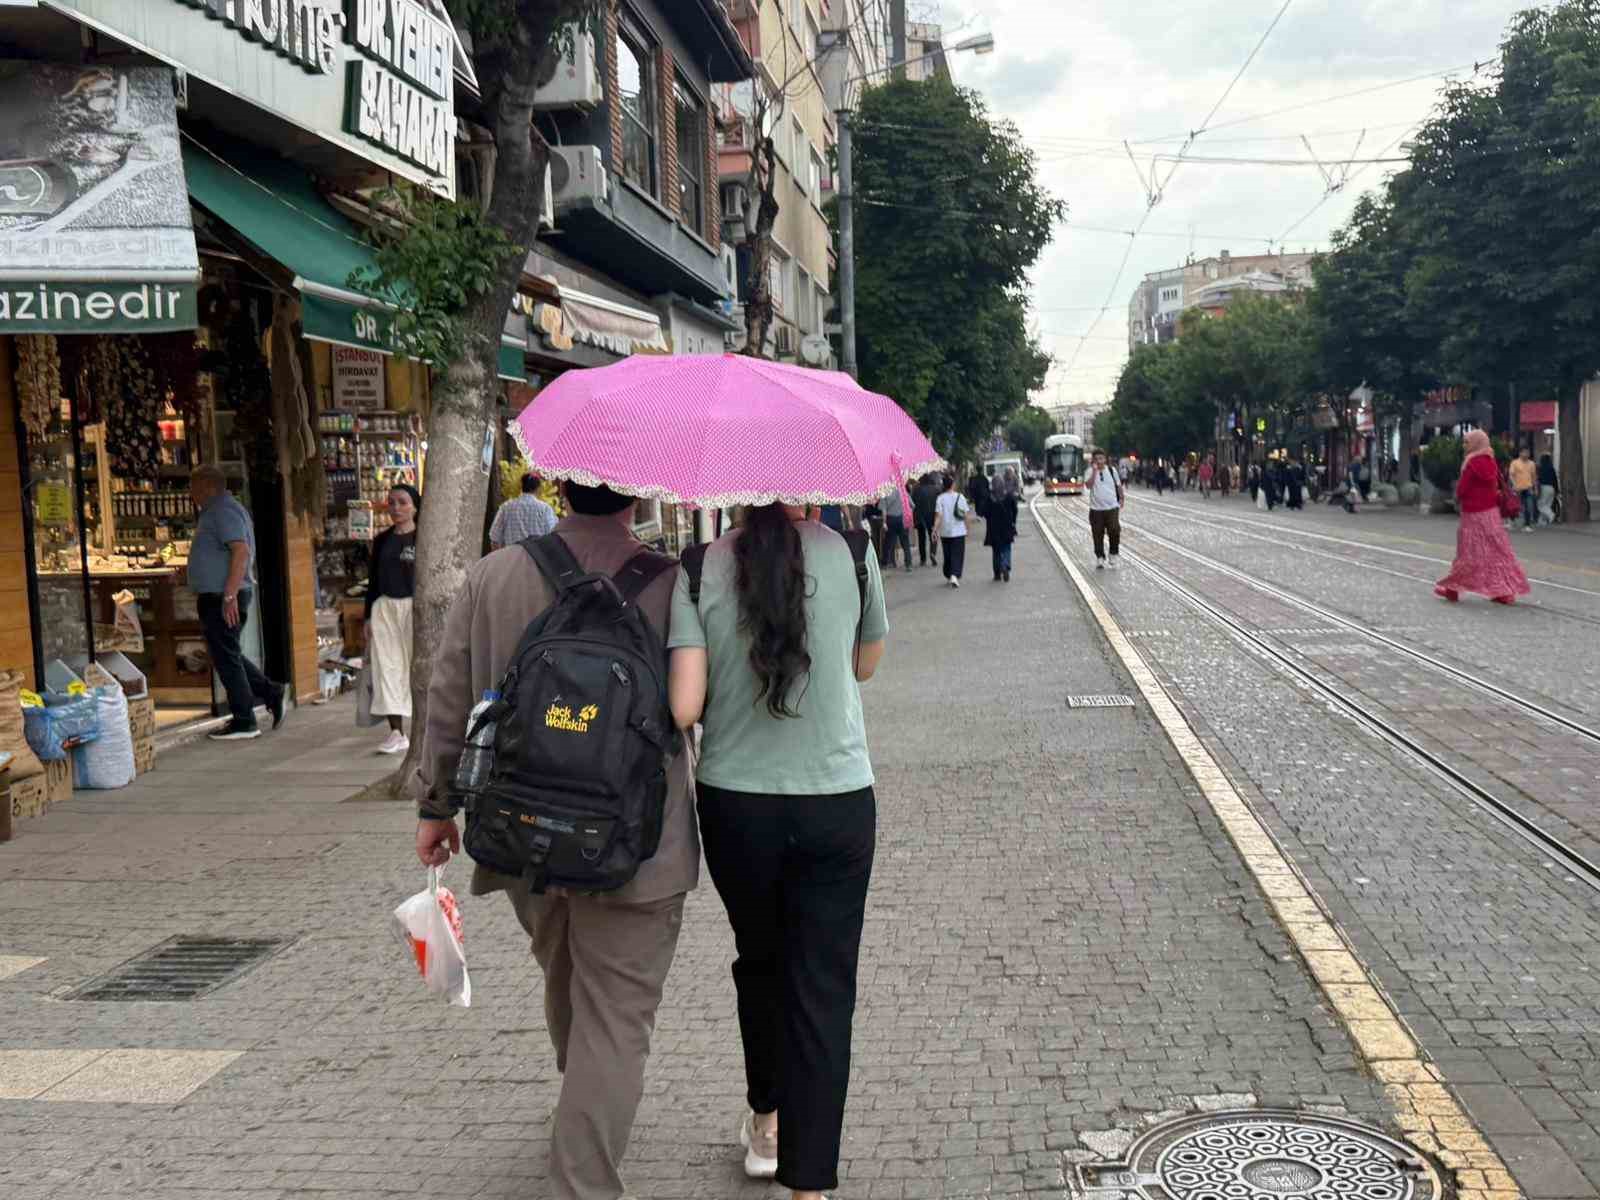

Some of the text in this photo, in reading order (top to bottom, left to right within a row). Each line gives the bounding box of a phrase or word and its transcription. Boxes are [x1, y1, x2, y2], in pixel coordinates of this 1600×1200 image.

[360, 60, 457, 178] BAHARAT
[547, 704, 572, 719] Jack
[545, 714, 589, 733] Wolfskin
